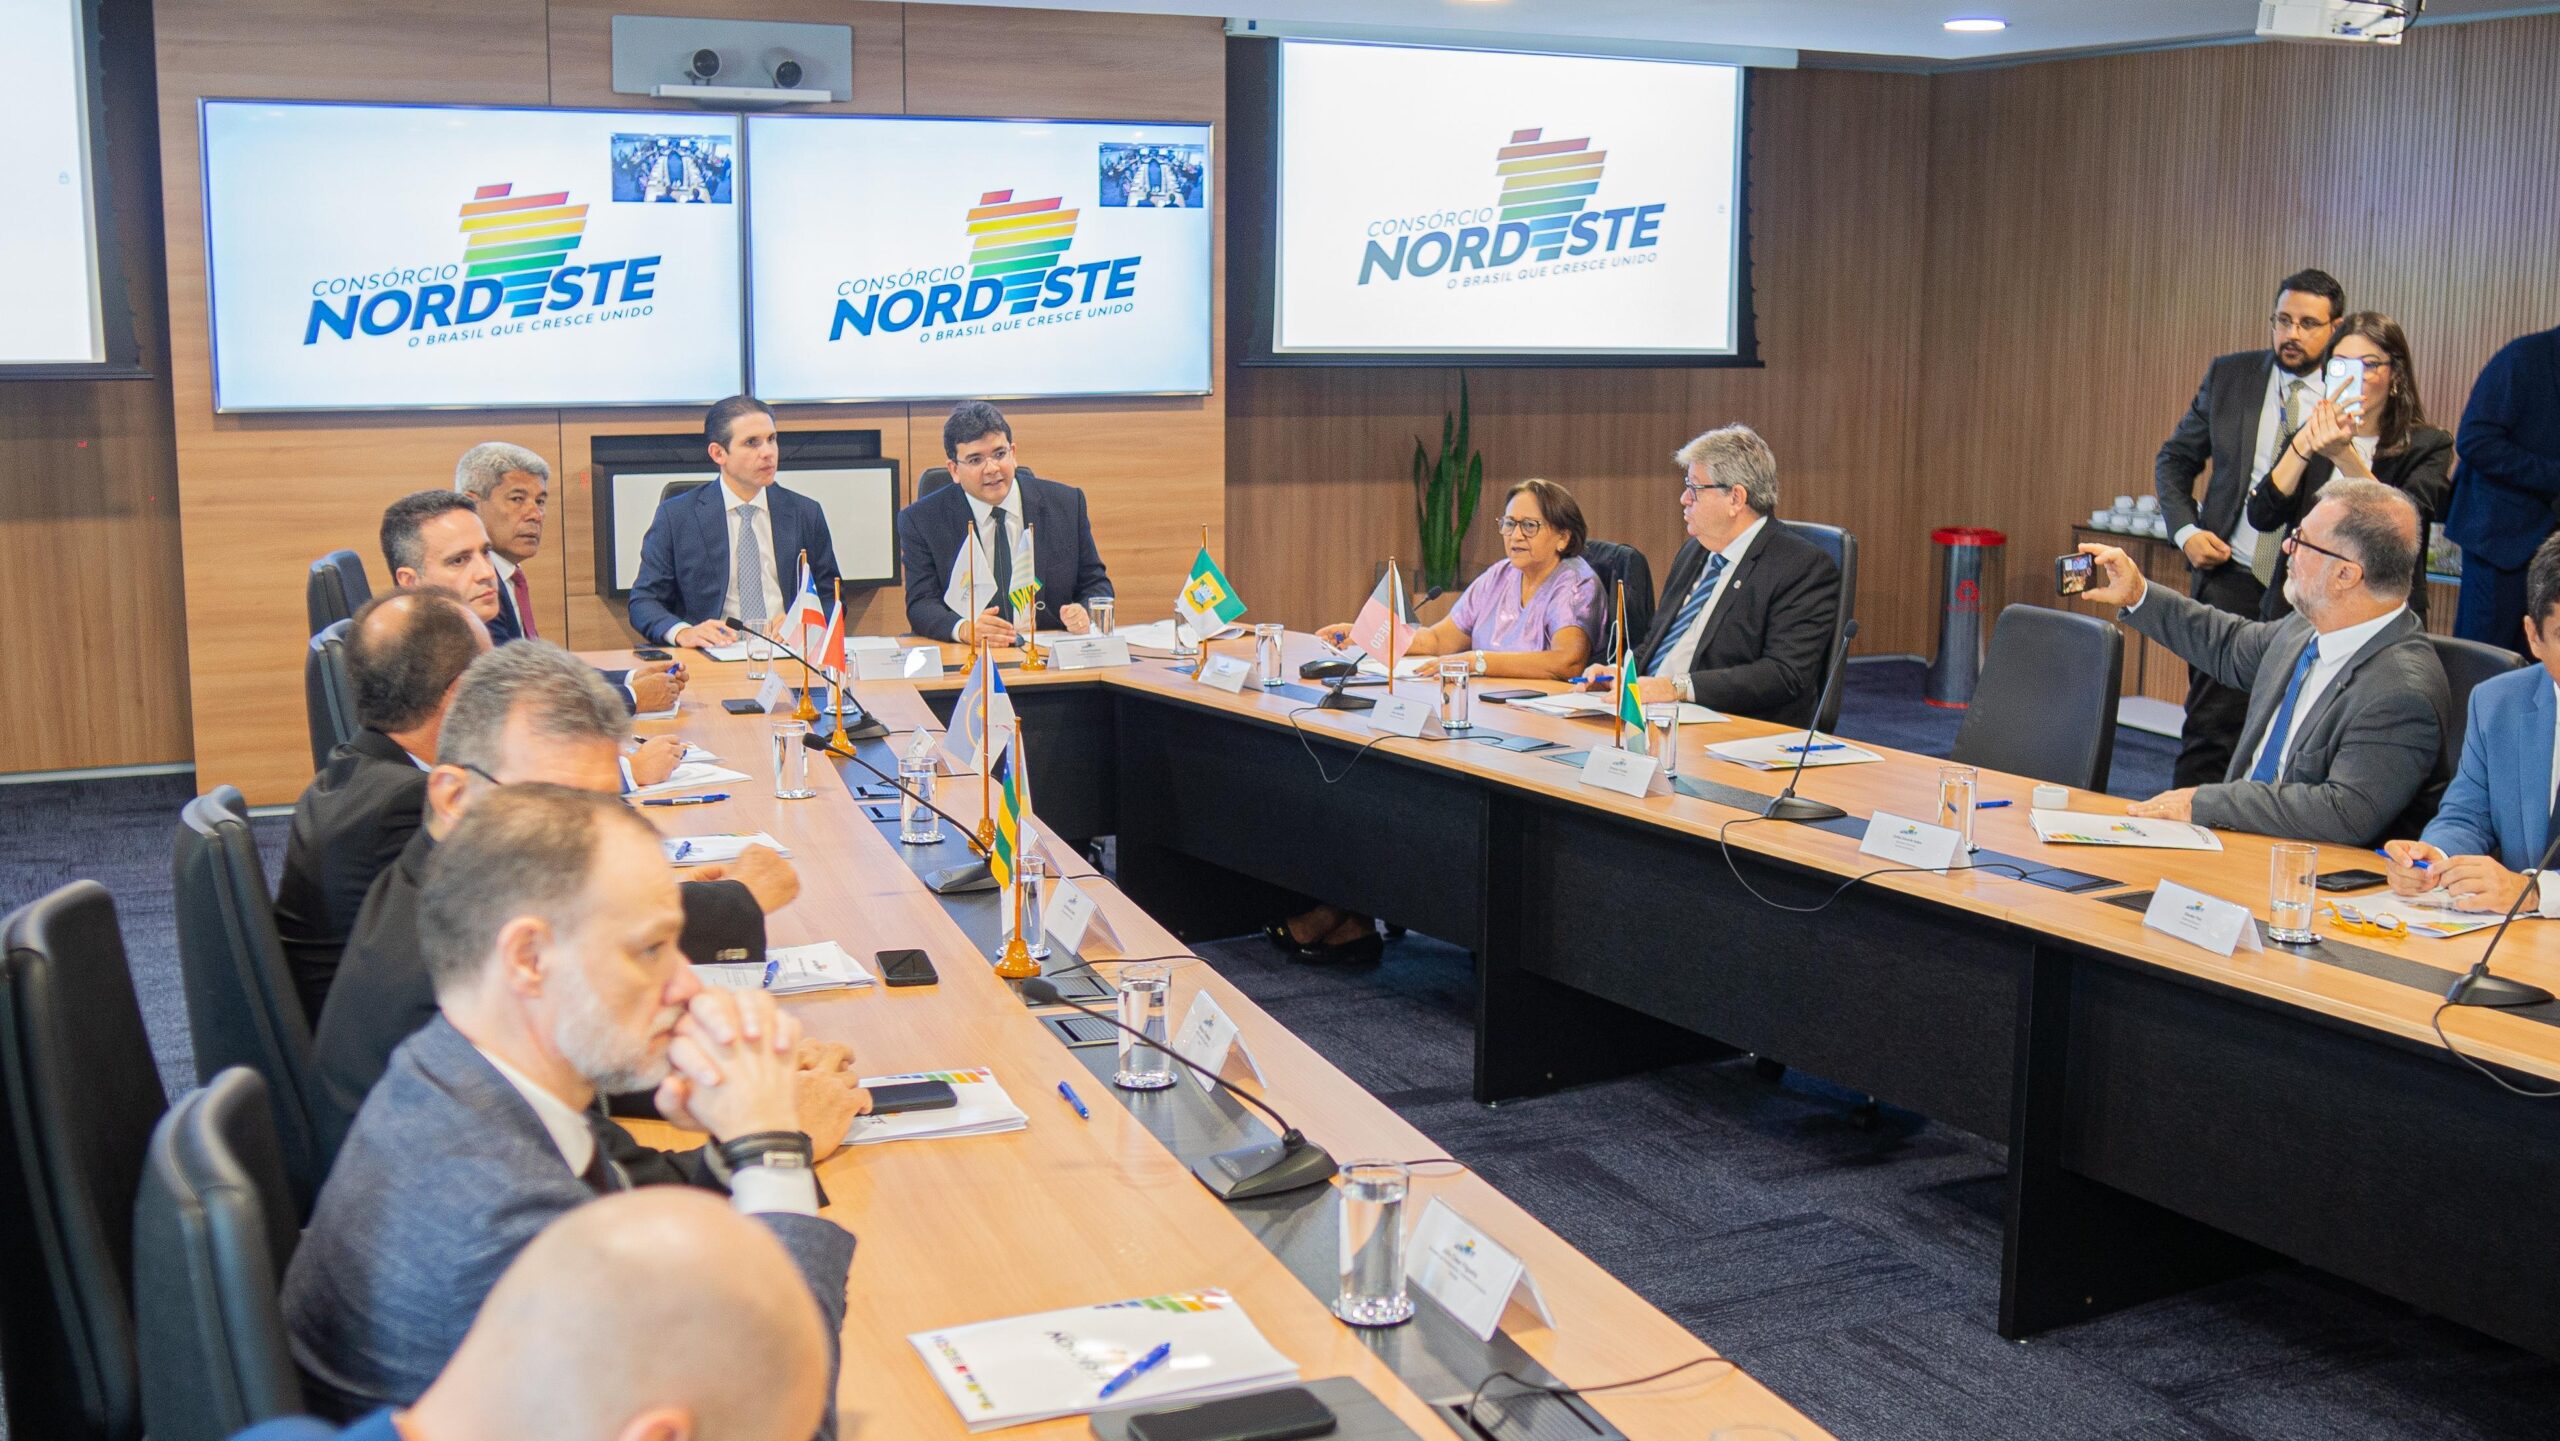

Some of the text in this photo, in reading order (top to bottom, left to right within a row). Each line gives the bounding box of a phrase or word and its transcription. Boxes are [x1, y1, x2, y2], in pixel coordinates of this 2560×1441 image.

[1367, 207, 1493, 237] CONSÓRCIO
[1357, 203, 1666, 286] NORDESTE
[312, 264, 458, 296] CONSÓRCIO
[837, 265, 965, 296] CONSÓRCIO
[1447, 252, 1658, 289] O BRASIL QUE CRESCE UNIDO
[303, 255, 661, 345] NORDESTE
[829, 256, 1141, 341] NORDESTE
[408, 305, 653, 347] O BRASIL QUE CRESCE UNIDO
[920, 302, 1134, 343] O BRASIL QUE CRESCE UNIDO
